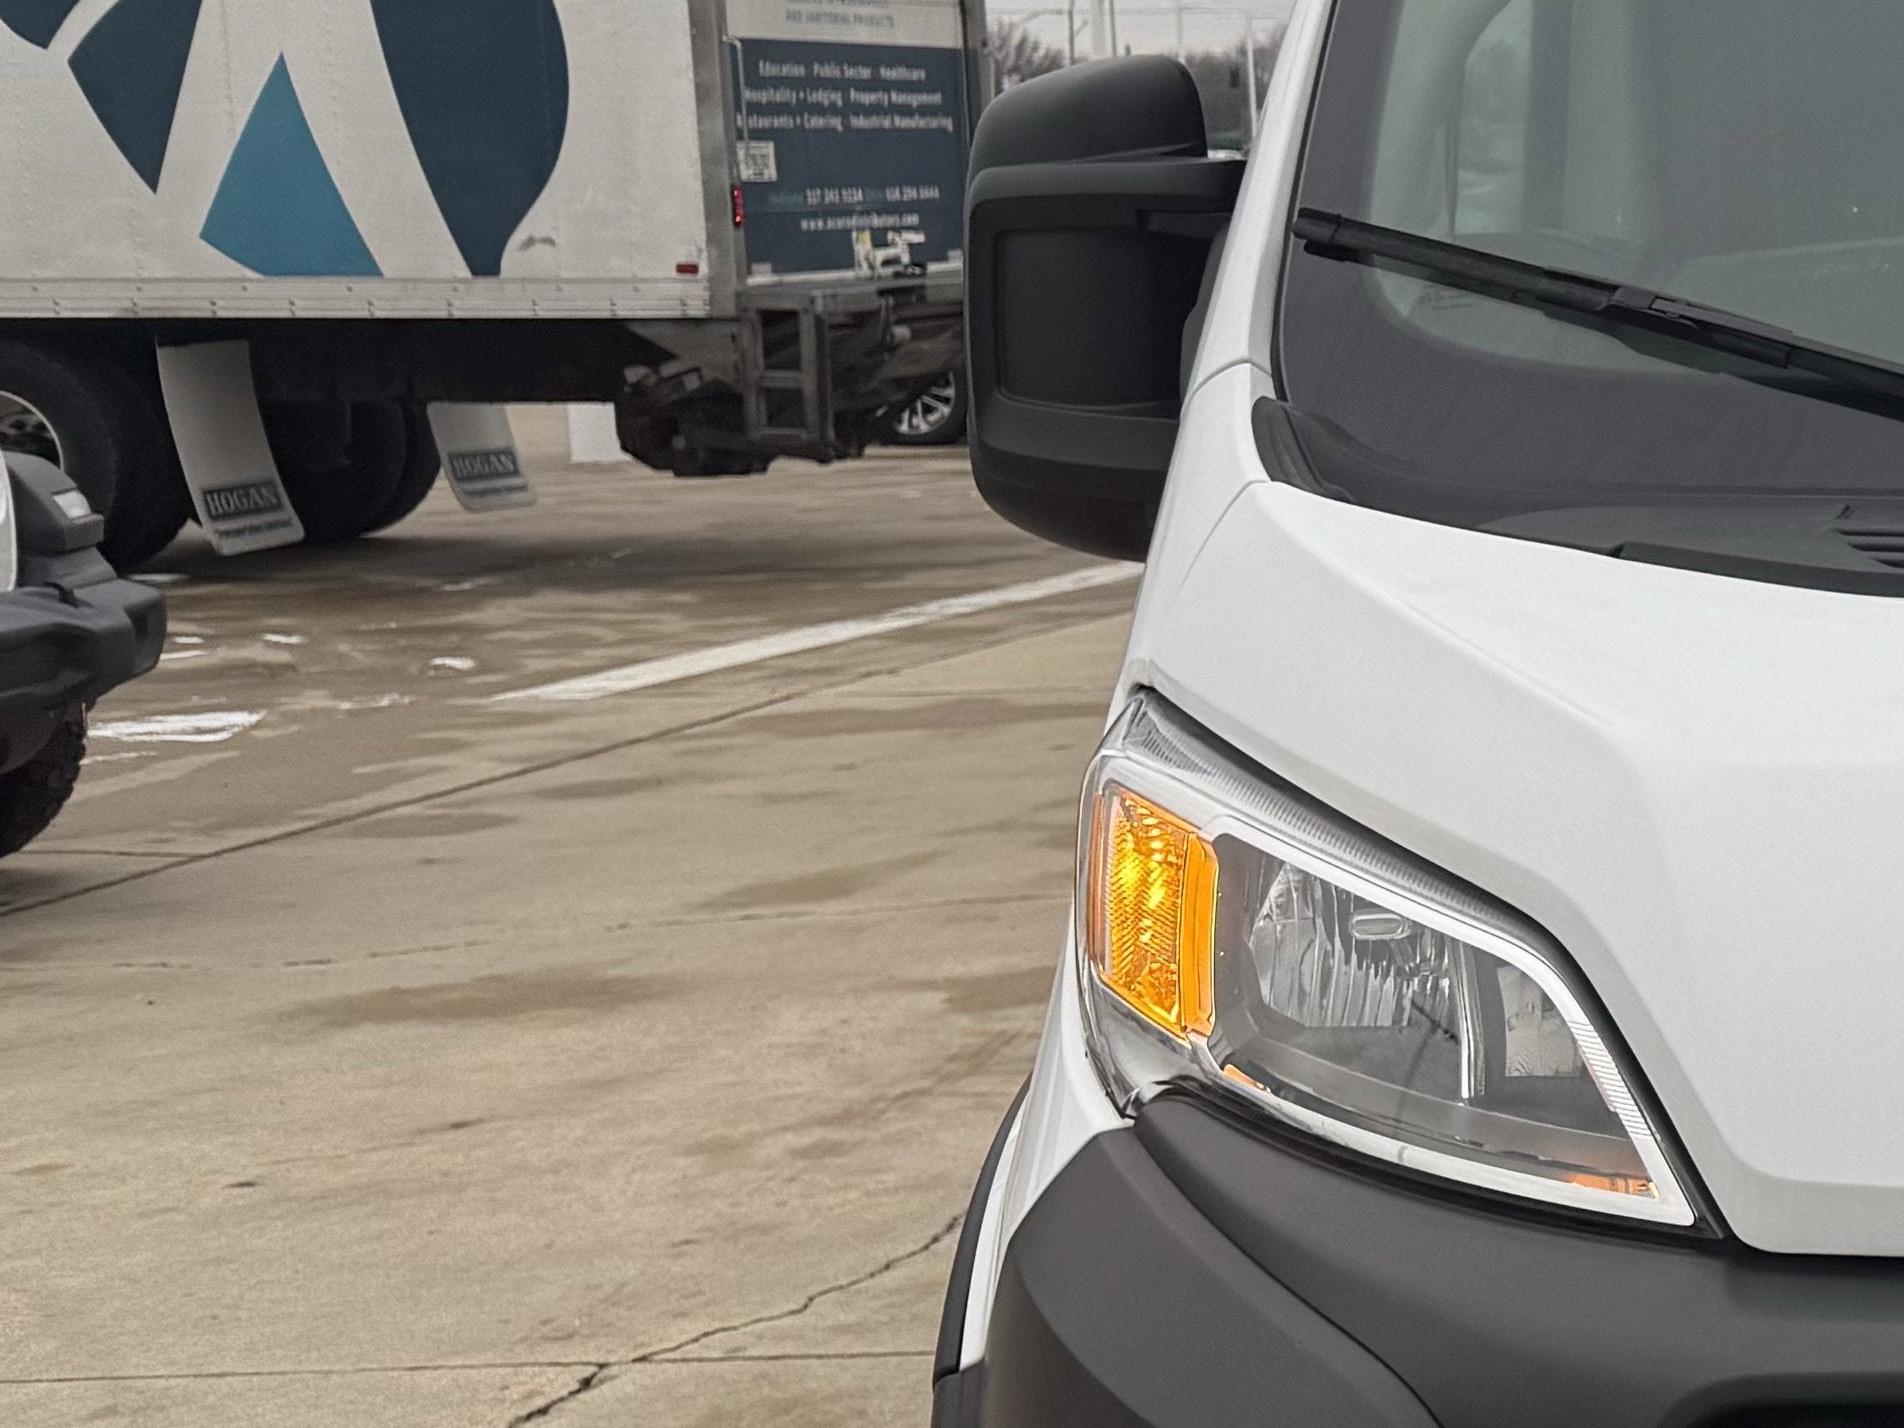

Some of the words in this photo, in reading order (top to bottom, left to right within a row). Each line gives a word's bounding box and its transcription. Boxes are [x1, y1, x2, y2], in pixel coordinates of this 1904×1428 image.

[759, 59, 805, 77] Education
[736, 112, 794, 129] Rstaurants
[206, 486, 279, 515] HOGAN
